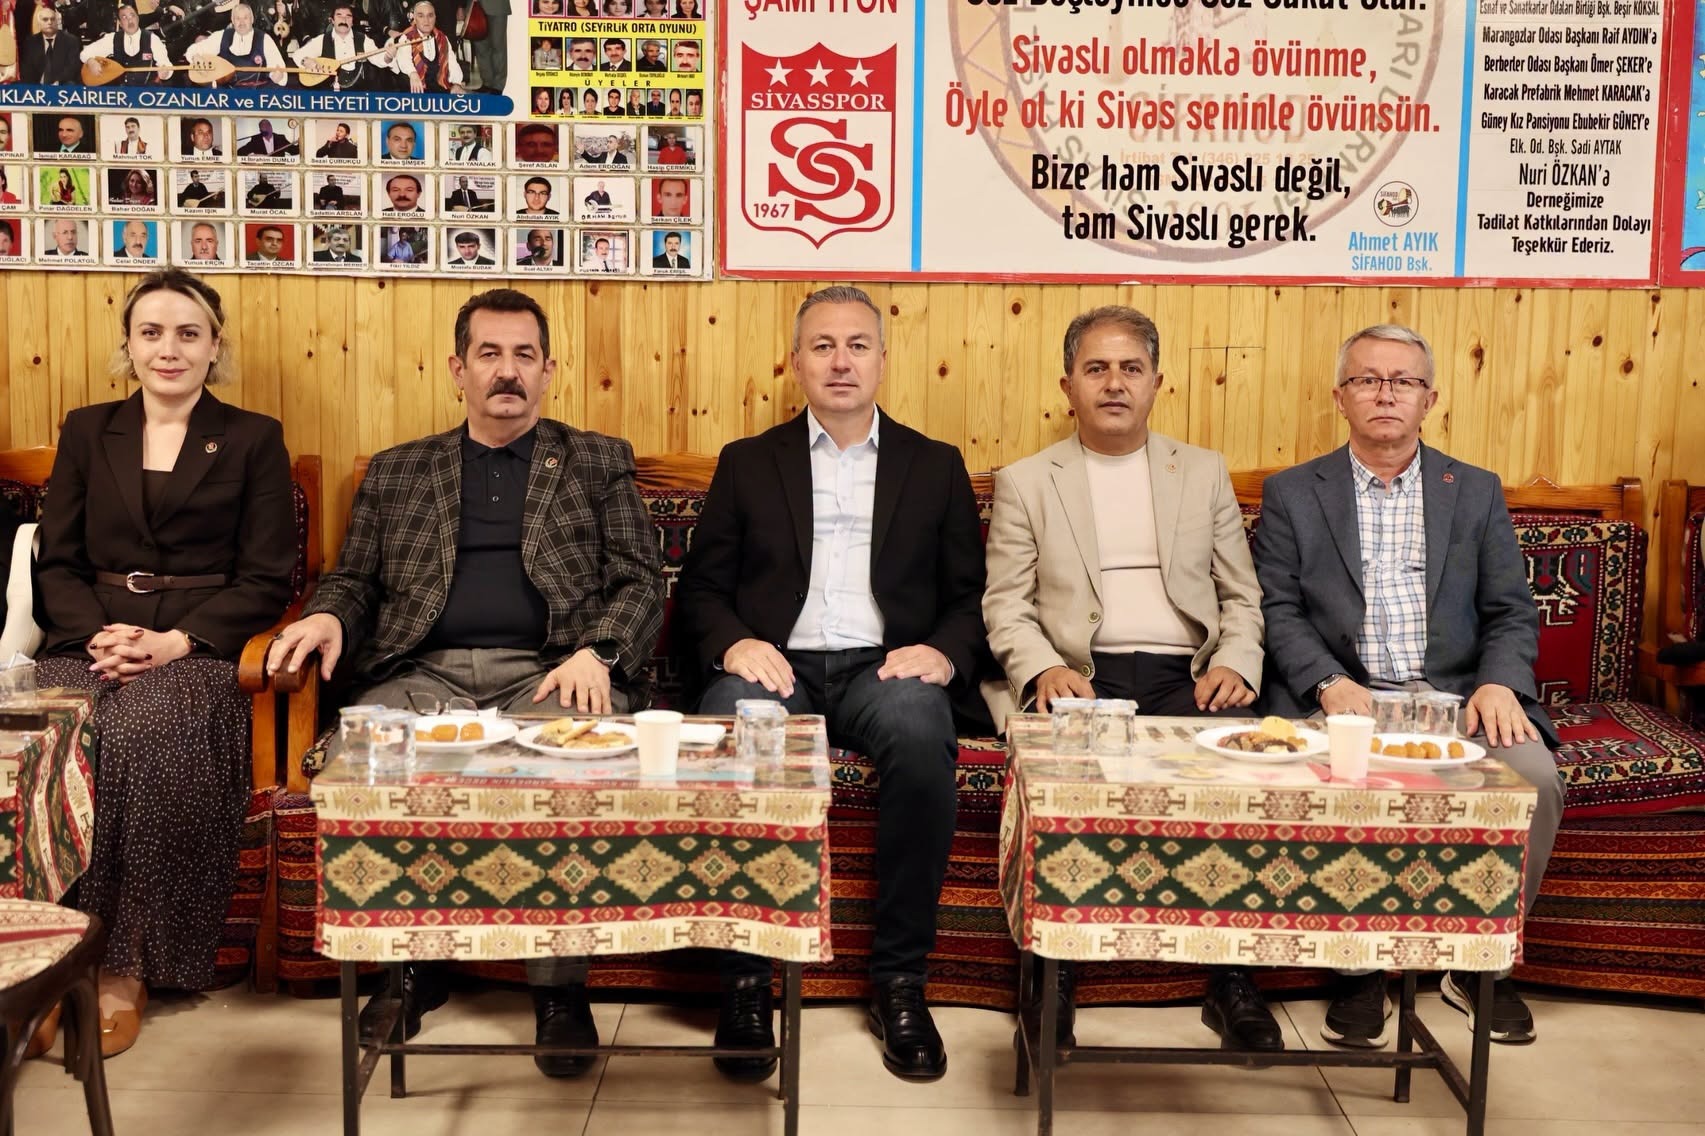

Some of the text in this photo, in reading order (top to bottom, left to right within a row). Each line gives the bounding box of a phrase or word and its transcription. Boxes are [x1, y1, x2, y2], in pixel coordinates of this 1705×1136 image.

[1480, 0, 1499, 15] Esnaf
[1500, 5, 1507, 15] ve
[1550, 0, 1573, 16] Odaları
[1576, 0, 1595, 18] Birliği
[1597, 0, 1612, 18] Bşk.
[1614, 0, 1632, 18] Beşir
[632, 22, 656, 33] ORTA
[659, 23, 697, 34] OYUNU)
[1482, 26, 1657, 47] Marangozlar Odası Başkanı Raif AYDIN'a
[1012, 35, 1377, 84] Sivaslı olmakla övünme,
[1484, 53, 1653, 76] Berberler Odası Başkanı Ömer ŞEKER'e
[58, 88, 132, 109] ŞAİRLER,
[139, 91, 229, 108] OZANLAR
[234, 97, 254, 108] ve
[260, 94, 306, 110] FASIL
[311, 92, 369, 111] HEYETİ
[376, 94, 481, 113] TOPLULUĞU
[750, 89, 887, 111] SİVASSPOR
[1484, 83, 1651, 102] Karacak Prefabrik Mehmet KARACAK'a
[946, 82, 1440, 136] Öyle ol ki Sivas seninle övünsün.
[1481, 111, 1508, 133] Güney
[1511, 112, 1523, 129] Kız
[1526, 112, 1570, 133] Pansiyonu
[1573, 113, 1610, 130] Ebubekir
[1509, 138, 1622, 158] Elk. Od. Bşk. Sadi AYTAK
[1032, 153, 1090, 191] Bize
[1102, 155, 1160, 192] ham
[1171, 155, 1263, 193] Sivaslı
[1275, 156, 1351, 201] değil,
[1519, 159, 1610, 187] Nuri ÖZKAN'a
[753, 202, 790, 218] 1967
[1526, 191, 1604, 211] Derneğimize
[1062, 203, 1316, 249] tam Sivaslı gerek.
[1477, 213, 1651, 235] Tadilat Katkılarından Dolayı
[1348, 231, 1440, 253] Ahmet AYIK
[1511, 236, 1614, 256] Teşekkür Ederiz.
[1351, 254, 1433, 274] SİFAHOD Bşk.
